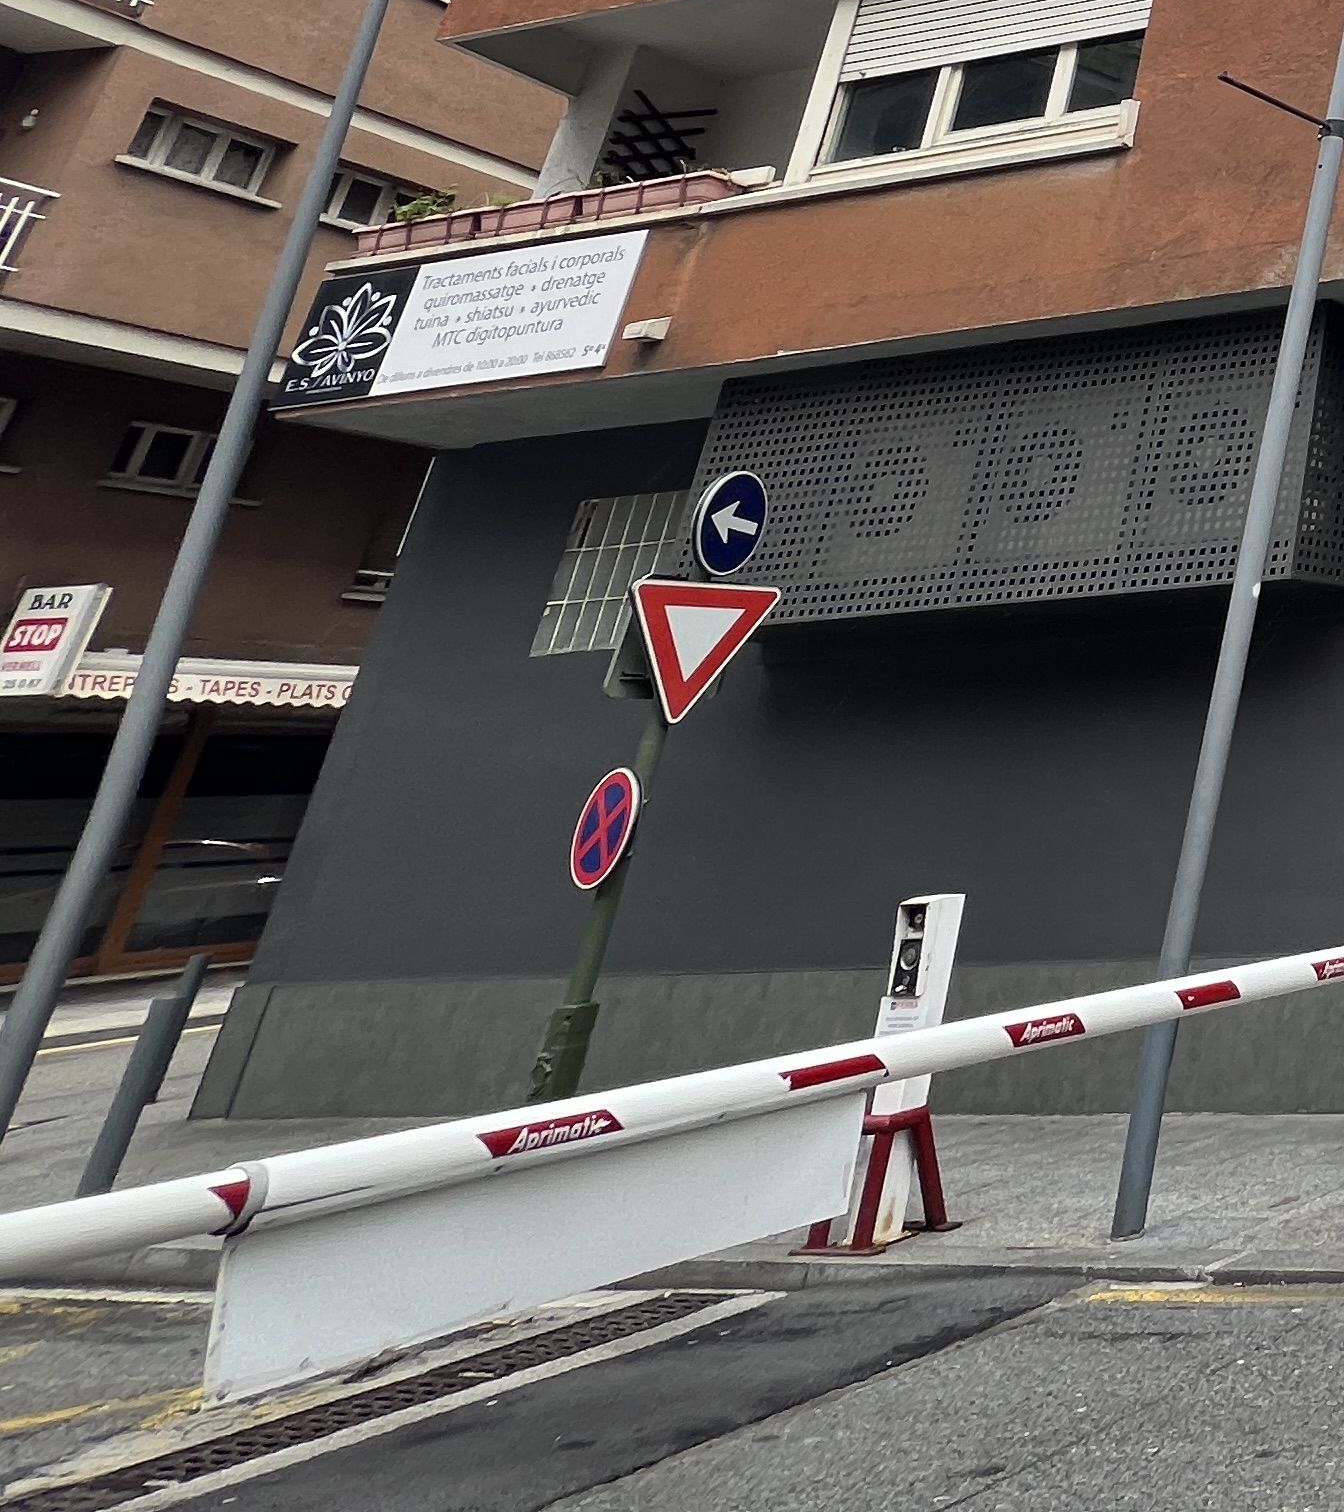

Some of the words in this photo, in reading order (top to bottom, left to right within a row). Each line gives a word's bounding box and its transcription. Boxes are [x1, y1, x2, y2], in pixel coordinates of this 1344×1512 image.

[423, 266, 504, 290] Tractaments
[505, 256, 549, 277] facials
[558, 245, 626, 270] corporals
[423, 283, 524, 313] quiromassatge
[541, 271, 606, 292] drenatge
[414, 314, 449, 331] tuina
[464, 304, 515, 324] shiatsu
[530, 289, 602, 317] ayurvedic
[431, 328, 467, 349] MTC
[465, 317, 564, 346] digitopuntura
[28, 592, 74, 611] BAR
[8, 623, 63, 647] STOP
[200, 679, 261, 698] TAPES
[276, 683, 337, 701] PLATS
